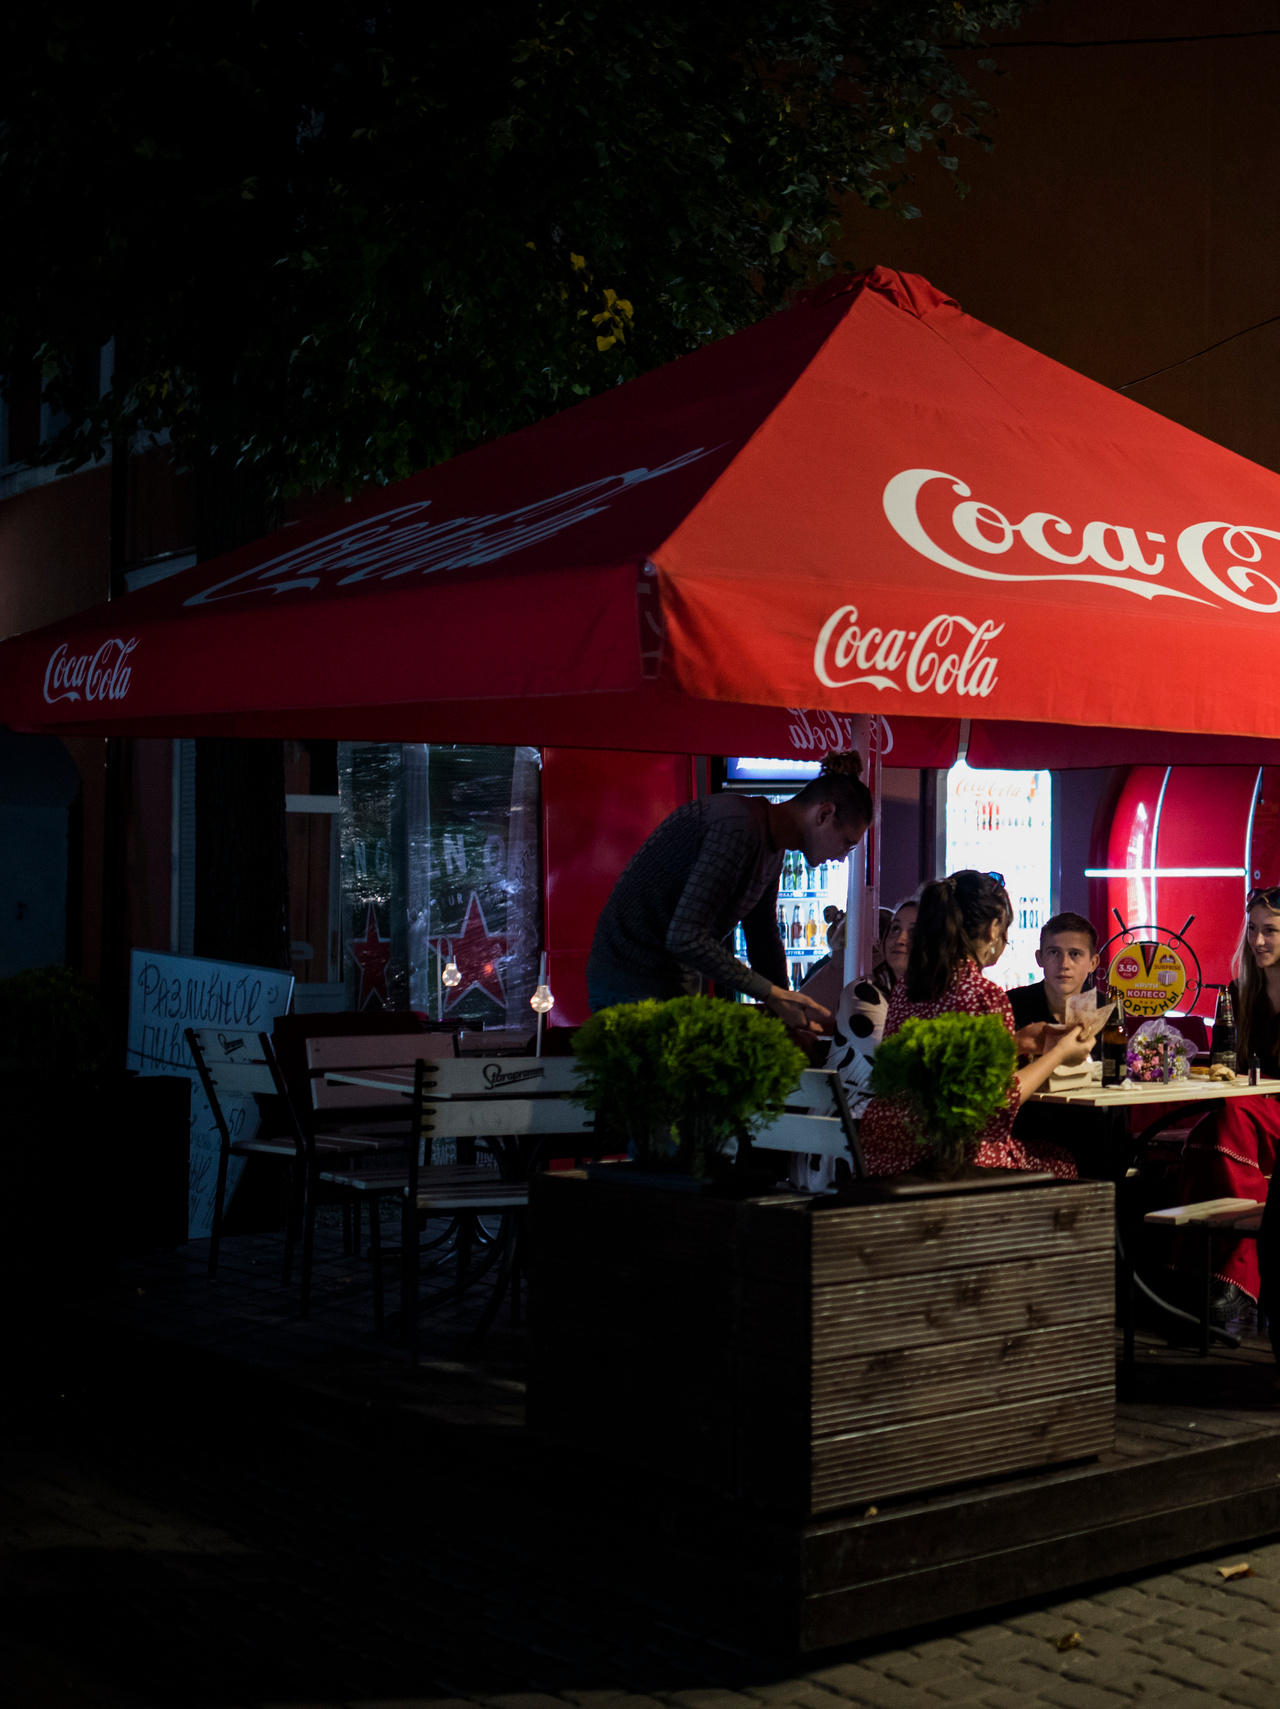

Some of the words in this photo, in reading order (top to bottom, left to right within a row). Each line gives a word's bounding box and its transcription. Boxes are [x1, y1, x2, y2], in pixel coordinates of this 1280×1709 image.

[43, 637, 141, 704] Coca-Cola
[814, 605, 1005, 698] Coca-Cola
[1118, 964, 1138, 973] 3.50
[1127, 990, 1166, 998] КОЛЕСО
